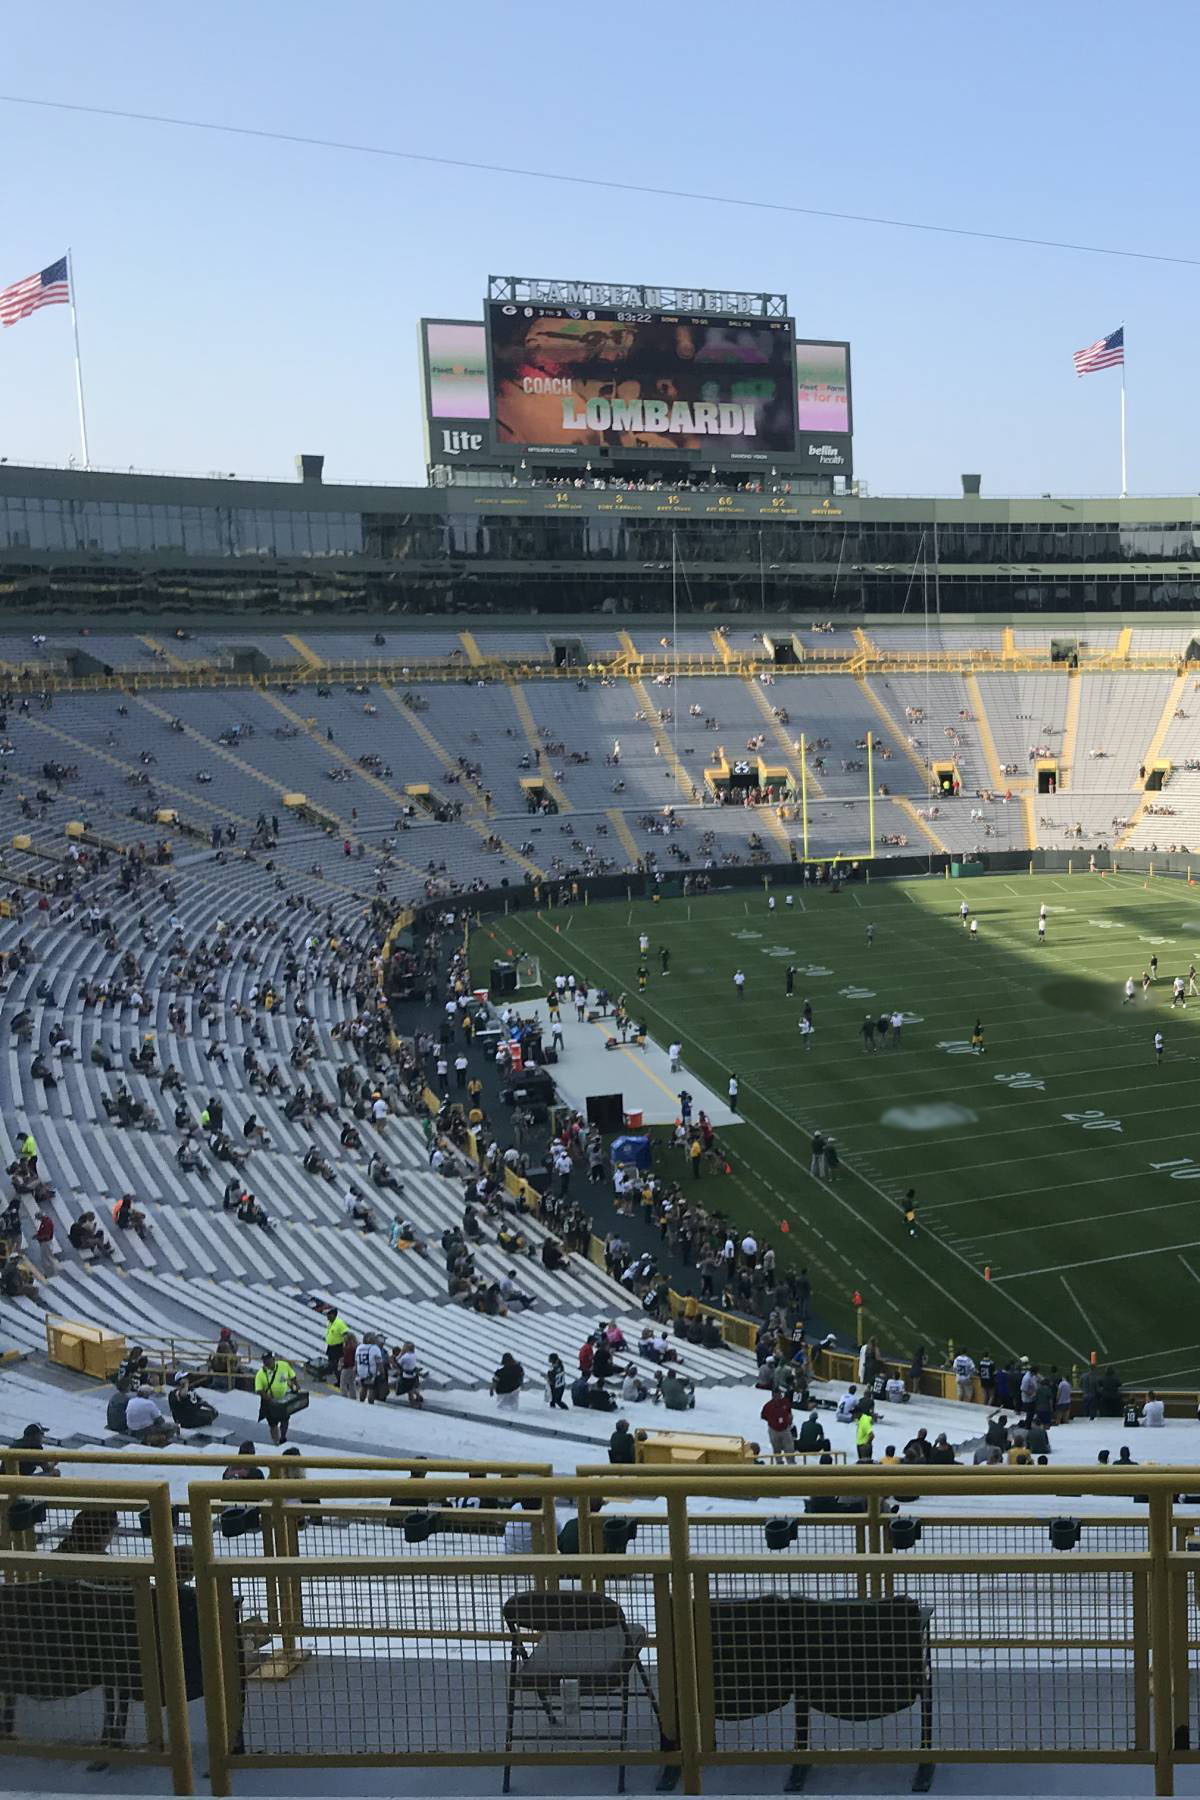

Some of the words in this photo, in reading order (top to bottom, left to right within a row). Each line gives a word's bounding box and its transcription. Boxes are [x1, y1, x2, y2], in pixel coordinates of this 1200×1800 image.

[529, 281, 661, 307] LAMBEAU
[676, 290, 752, 313] FIELD
[617, 312, 651, 323] 83:22
[523, 377, 572, 394] COACH
[562, 396, 756, 436] LOMBARDI
[442, 429, 482, 455] Lite
[808, 445, 839, 456] bellin
[734, 760, 749, 774] 25
[994, 1071, 1046, 1090] 30
[1061, 1110, 1123, 1131] 20
